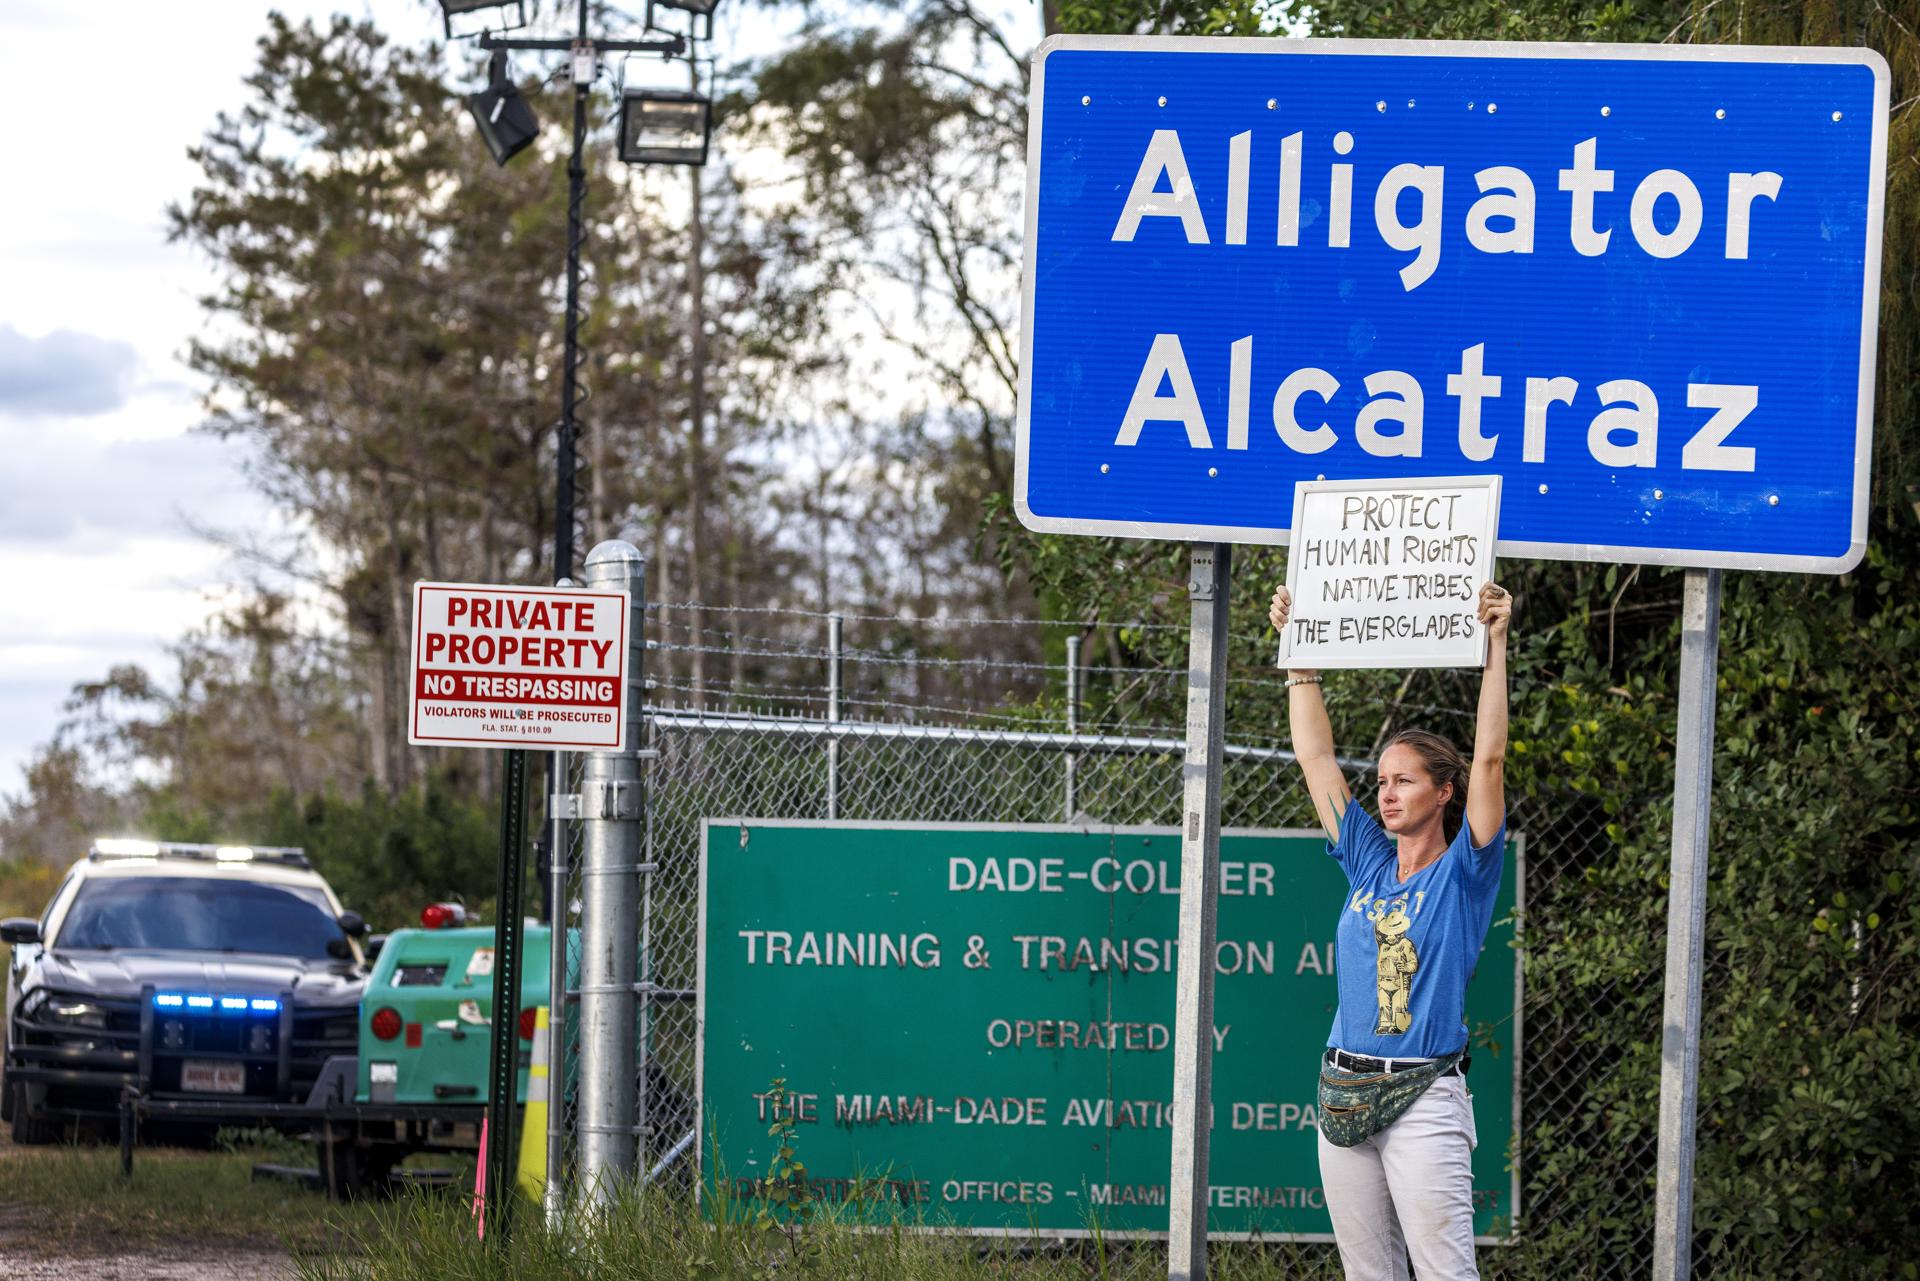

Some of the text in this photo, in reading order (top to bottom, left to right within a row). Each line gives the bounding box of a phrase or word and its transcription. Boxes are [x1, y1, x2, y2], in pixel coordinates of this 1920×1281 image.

[1111, 128, 1783, 292] Alligator
[1115, 333, 1759, 472] Alcatraz
[1341, 493, 1462, 532] PROTECT
[1304, 534, 1478, 570] HUMAN RIGHTS
[1323, 574, 1473, 603] NATIVE TRIBES
[447, 596, 595, 633] PRIVATE
[1294, 613, 1475, 646] THE EVERGLADES
[425, 632, 614, 669] PROPERTY
[423, 674, 614, 702] NO TRESPASSING
[424, 706, 612, 723] VIOLATORS WILL BE PROSECUTED
[481, 724, 498, 732] FLA.
[500, 724, 520, 733] STAT.
[949, 857, 1276, 896] DADE-COLER
[738, 930, 942, 969] TRAINING
[962, 934, 992, 969] &
[1012, 935, 1275, 975] TRANSION
[987, 1019, 1170, 1050] OPERATED
[752, 1094, 818, 1122] THE
[835, 1094, 1048, 1125] MIAMI-DADE
[1062, 1099, 1215, 1128] AVIATI
[942, 1180, 1054, 1204] OFFICES
[1089, 1183, 1166, 1206] MIAMI
[1207, 1185, 1326, 1209] TERNATIO
